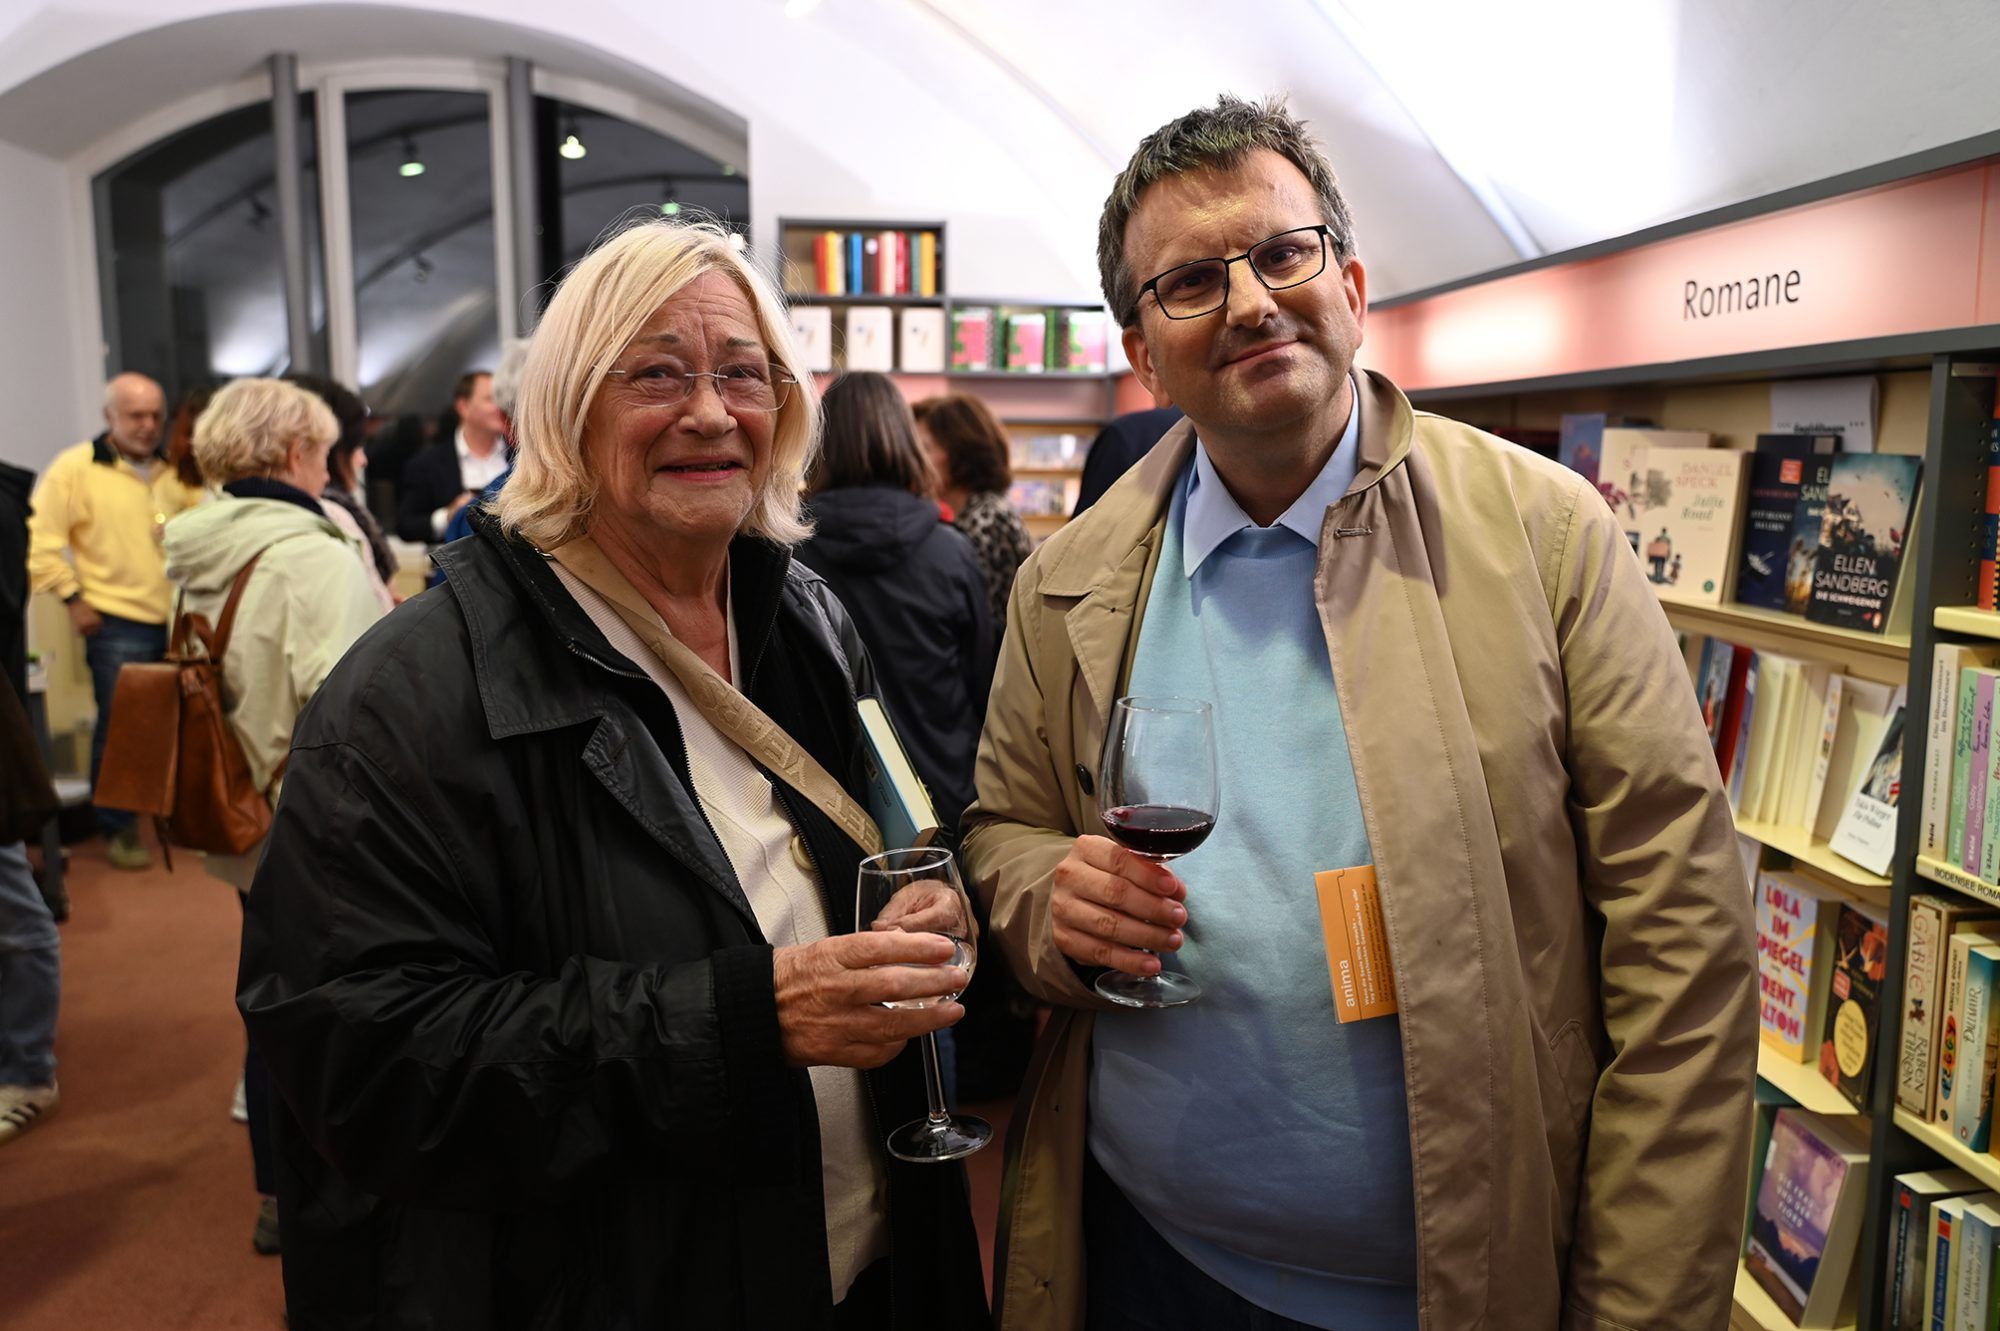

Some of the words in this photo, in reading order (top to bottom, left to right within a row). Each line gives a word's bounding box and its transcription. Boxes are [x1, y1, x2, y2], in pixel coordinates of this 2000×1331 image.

[1684, 270, 1800, 320] Romane
[1834, 554, 1876, 575] ELLEN
[1815, 570, 1889, 597] SANDBERG
[1967, 784, 1978, 809] Gaby
[1971, 769, 1987, 828] Hauptmann
[1985, 798, 1995, 823] Gaby
[1927, 822, 1935, 848] PIPER
[1966, 834, 1976, 861] PIPER
[1984, 842, 1994, 869] PIPER
[1934, 866, 1976, 892] BODENSEE
[1766, 885, 1801, 920] LOLA
[1772, 915, 1790, 940] IM
[1757, 930, 1804, 976] PIEGEL
[1337, 959, 1355, 1007] anima
[1362, 987, 1370, 1005] Wenn
[1759, 970, 1796, 1009] RENT
[1761, 1002, 1799, 1040] LTON
[1902, 1031, 1916, 1089] THRON
[1915, 1036, 1928, 1095] RABEN
[1940, 1022, 1957, 1091] PEGGY
